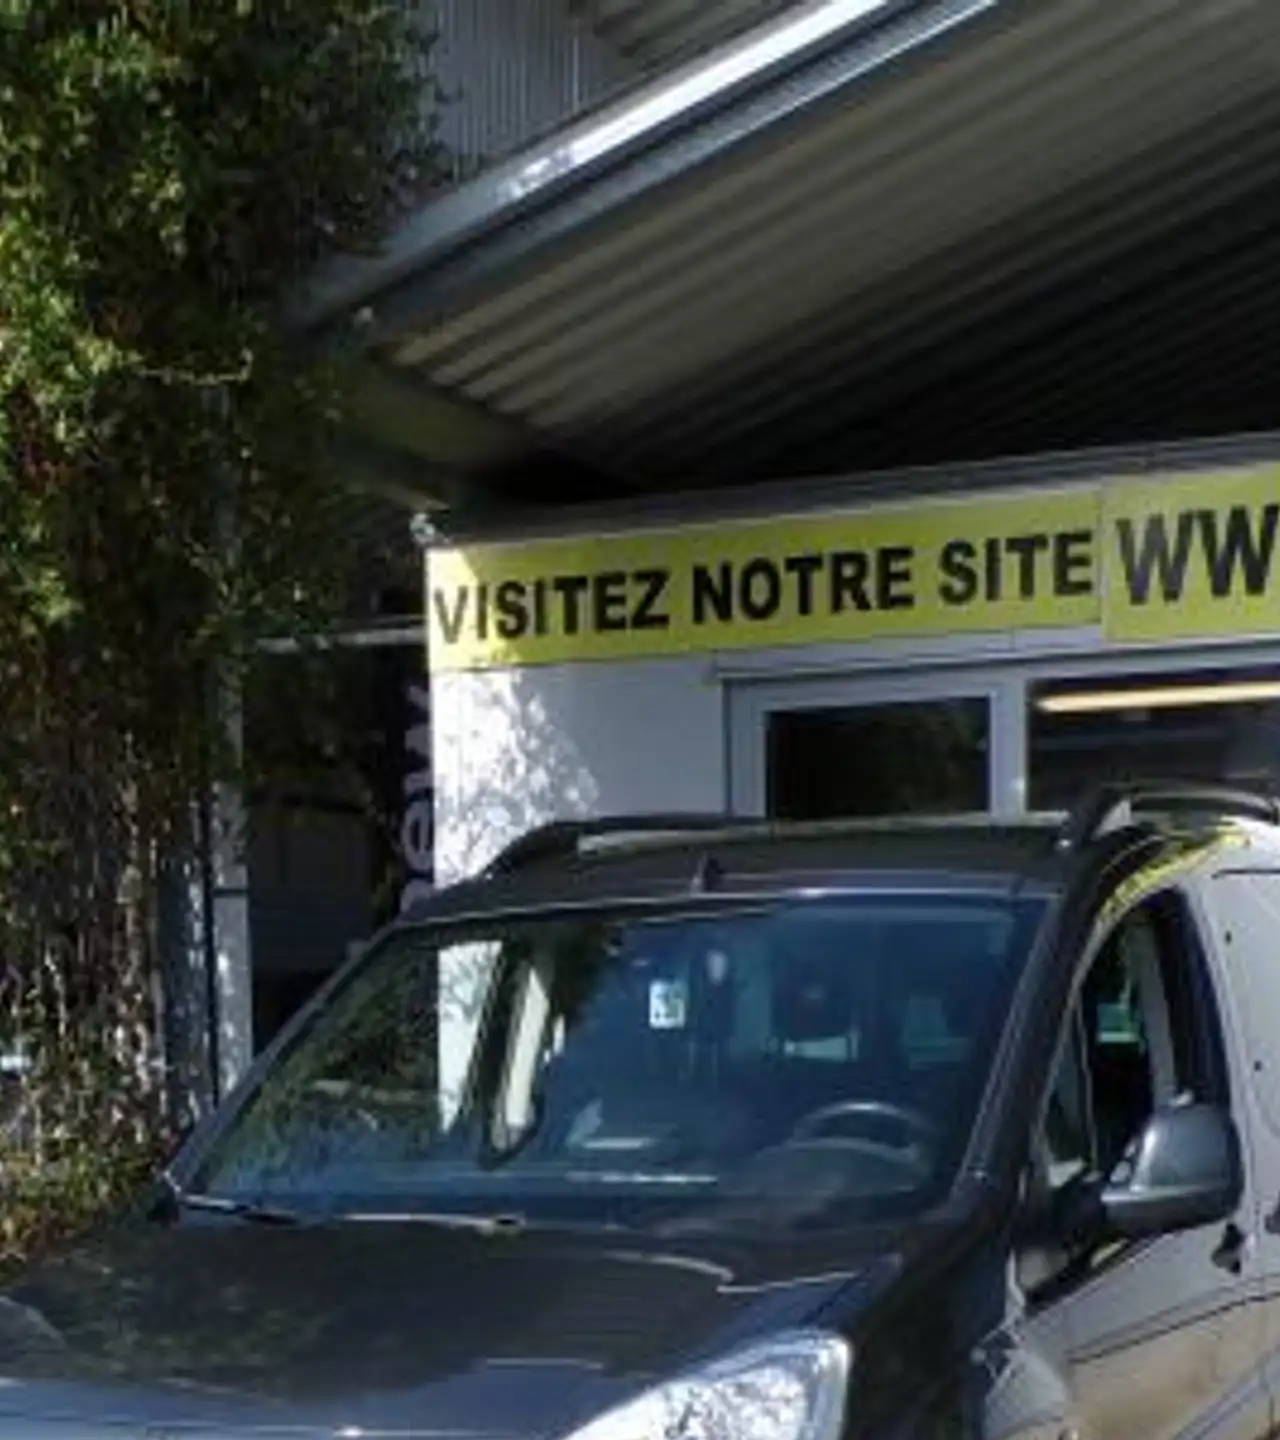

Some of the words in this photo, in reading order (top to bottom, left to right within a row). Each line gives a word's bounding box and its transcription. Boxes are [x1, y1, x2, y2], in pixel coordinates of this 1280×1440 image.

[435, 571, 671, 643] VISITEZ
[691, 547, 916, 623] NOTRE
[938, 531, 1093, 602] SITE
